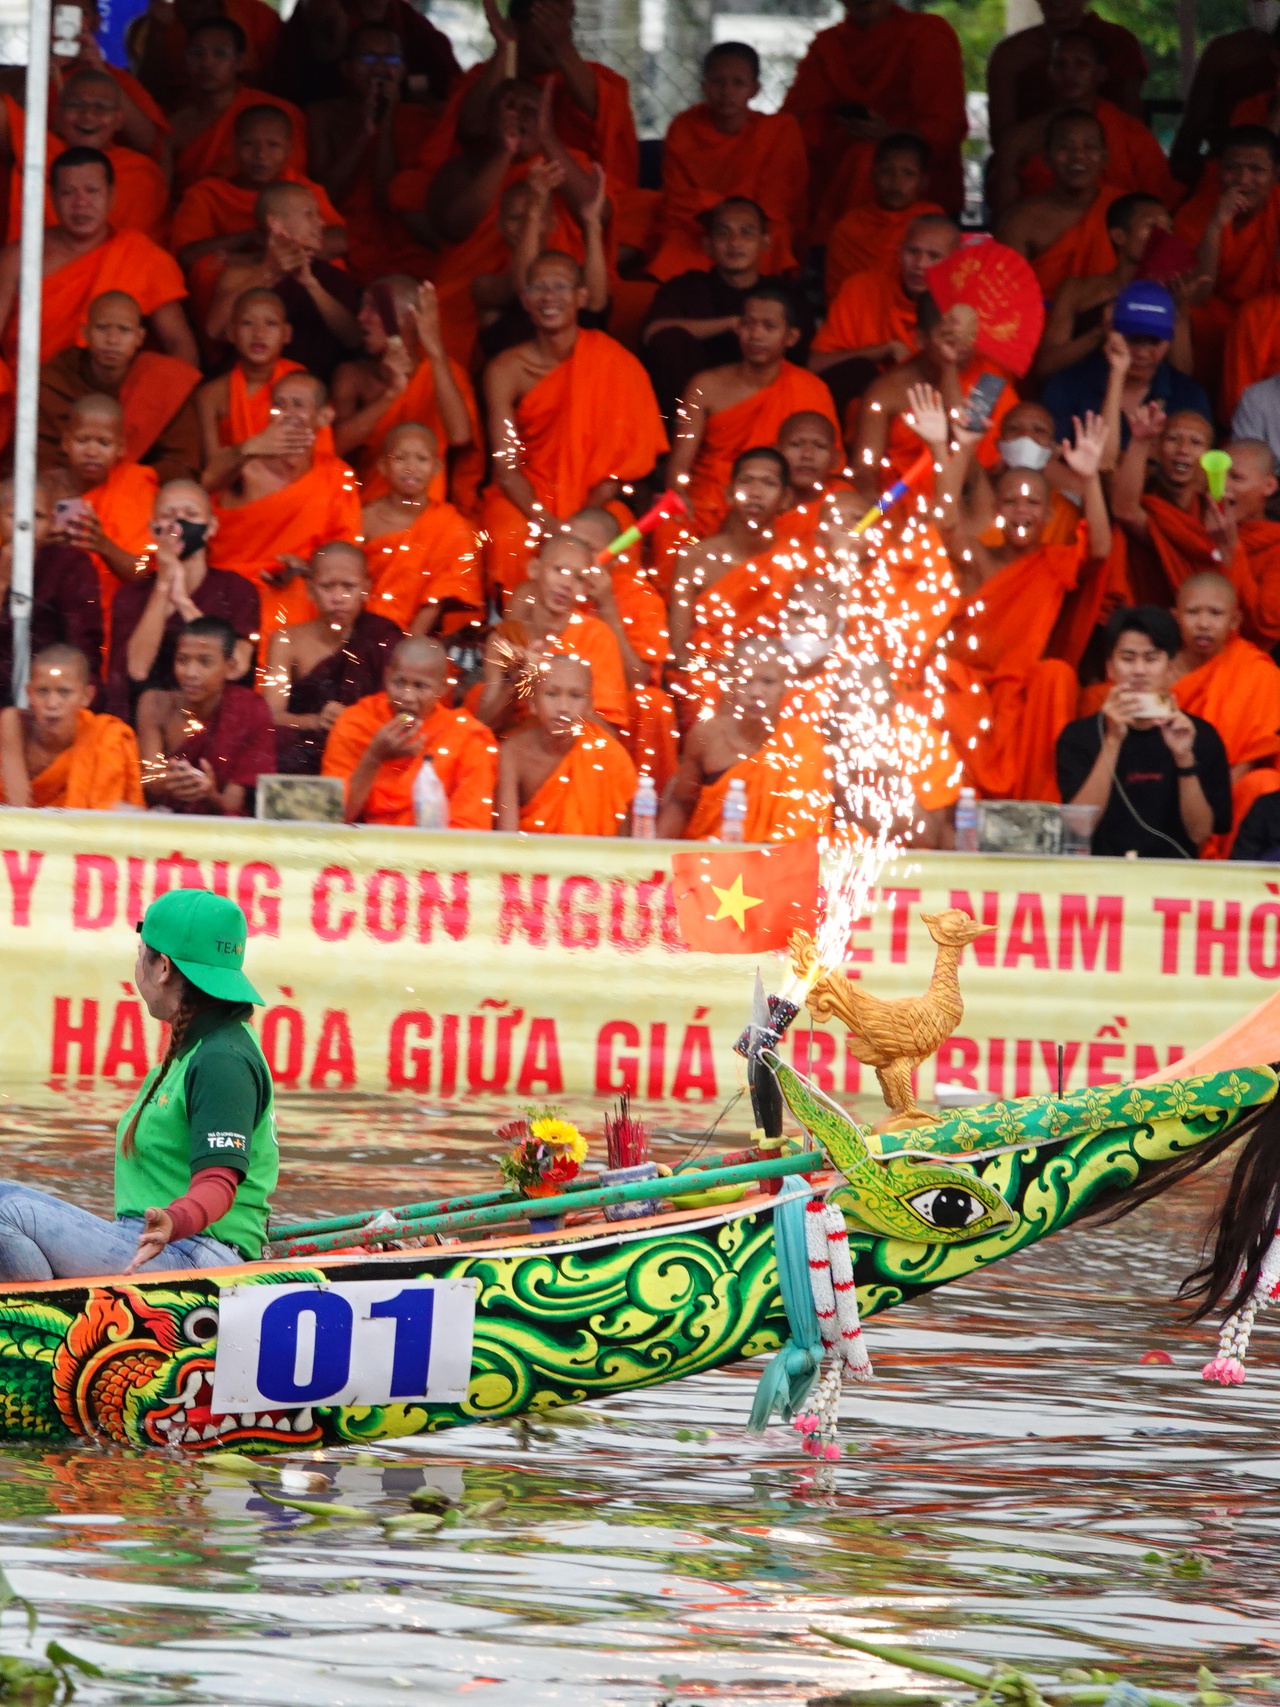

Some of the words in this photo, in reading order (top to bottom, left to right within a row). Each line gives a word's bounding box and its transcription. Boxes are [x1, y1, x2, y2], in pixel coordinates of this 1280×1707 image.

[310, 864, 471, 945] CON
[949, 888, 1125, 973] NAM
[250, 984, 359, 1090] ÒA
[386, 996, 566, 1096] GIỮA
[593, 1006, 718, 1099] GIÁ
[910, 1014, 1184, 1100] RUYỀN
[256, 1288, 435, 1403] 01
